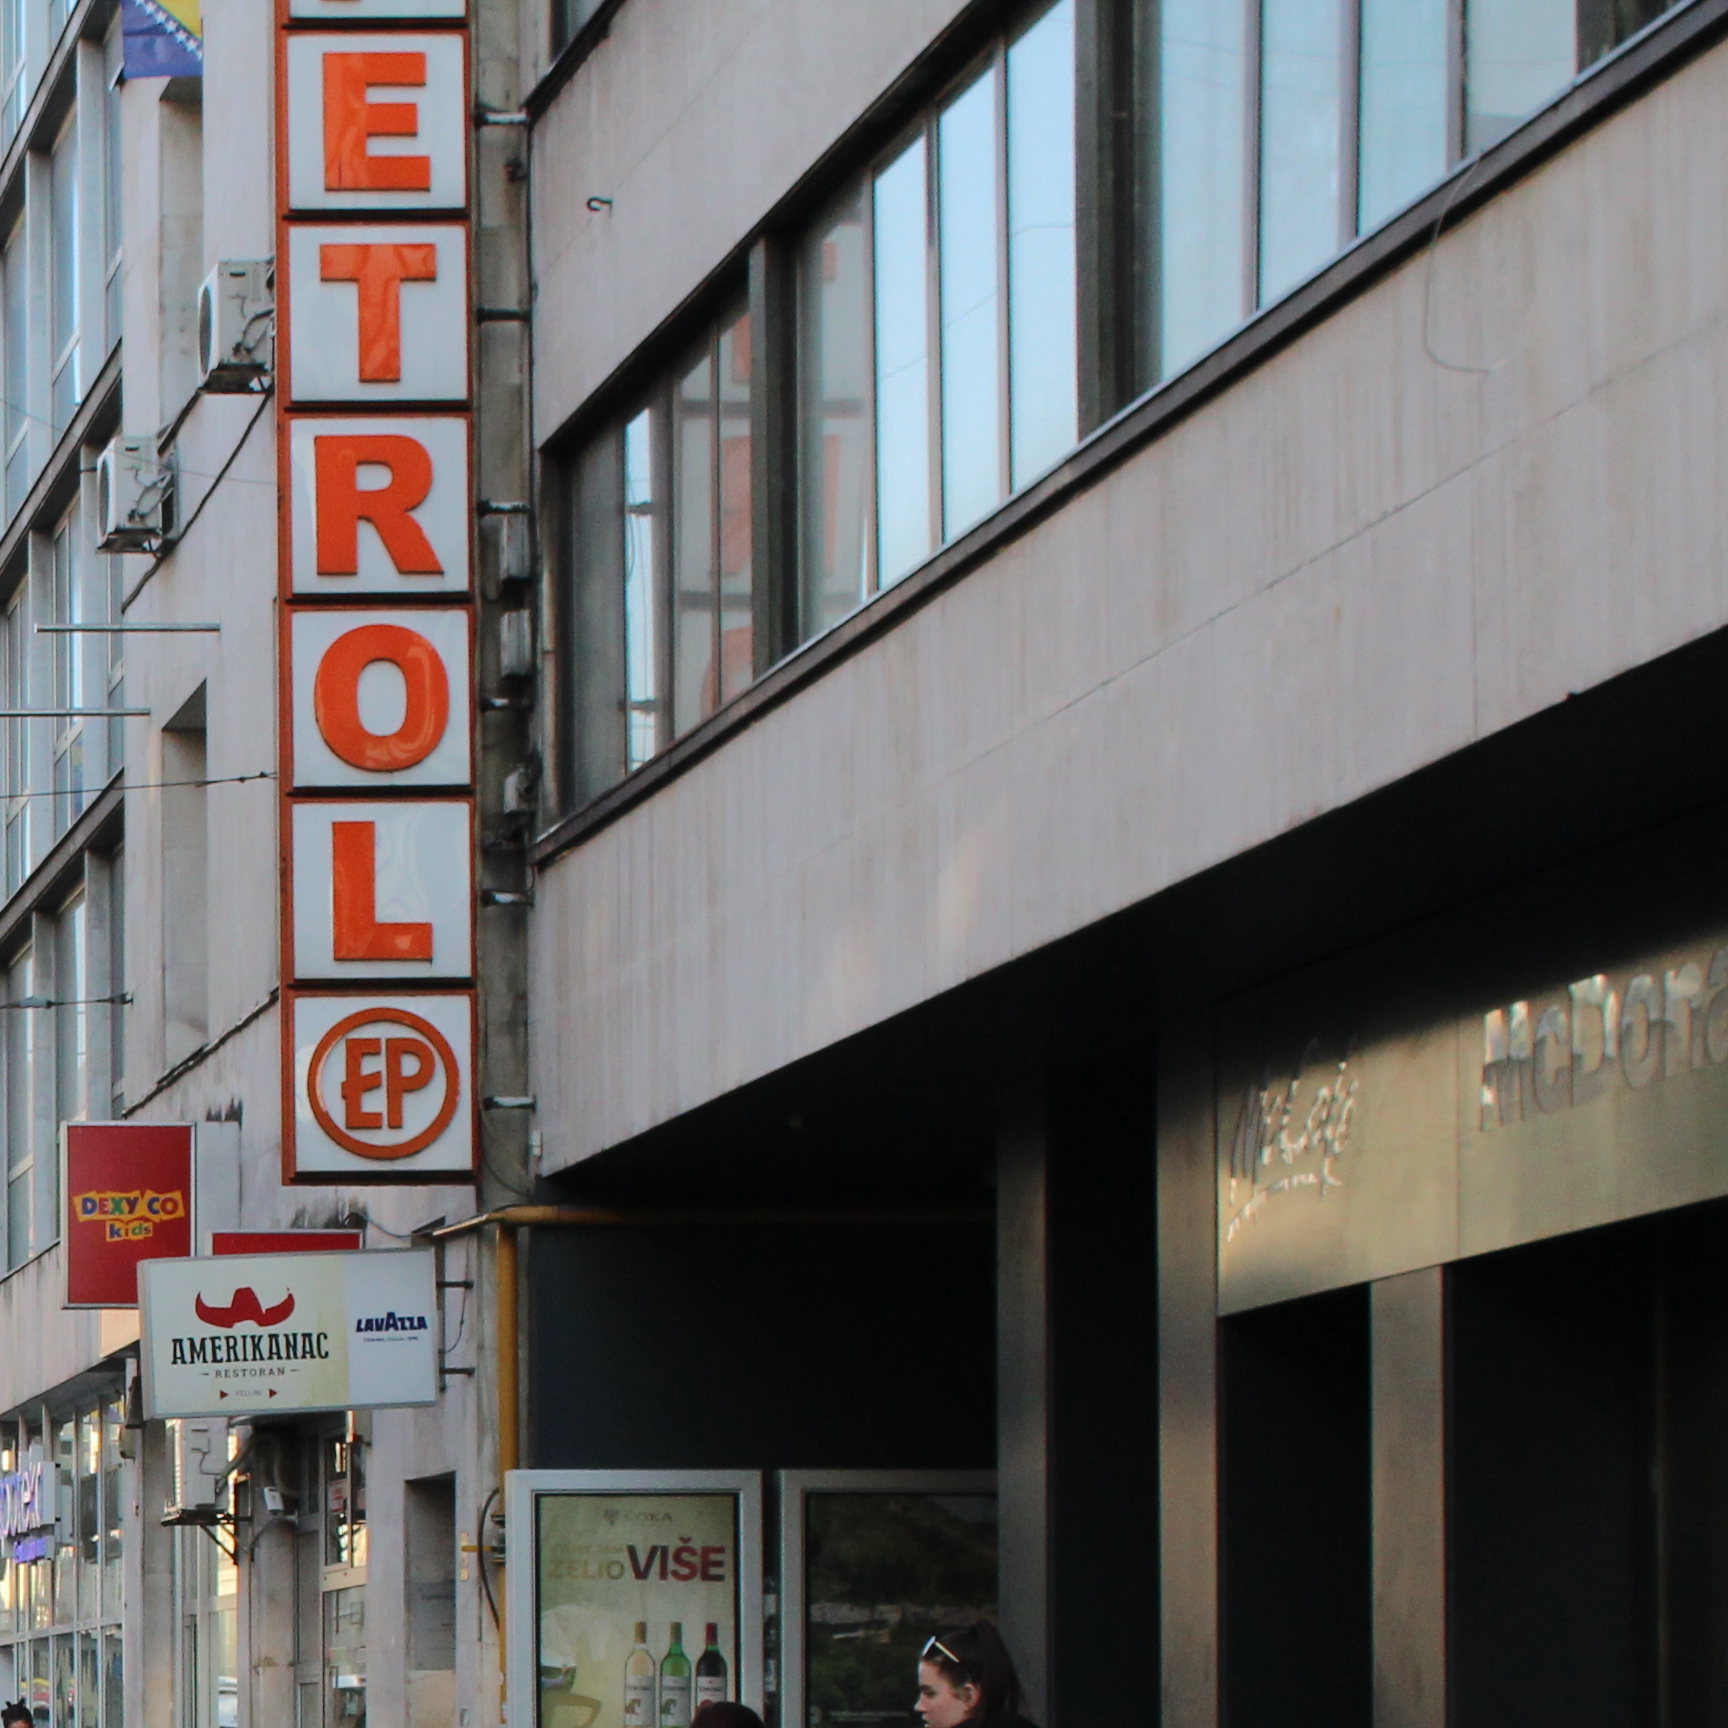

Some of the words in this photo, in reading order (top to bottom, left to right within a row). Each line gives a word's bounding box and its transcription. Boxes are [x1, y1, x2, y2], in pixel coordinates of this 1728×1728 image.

[314, 0, 450, 961] ETROL
[341, 1037, 435, 1130] EP
[81, 1197, 139, 1215] DEXY
[147, 1197, 179, 1215] CO
[109, 1223, 152, 1239] kids
[355, 1312, 428, 1333] LAVAZZA
[171, 1332, 330, 1365] AMERIKANAC
[215, 1367, 286, 1379] RESTORAN
[626, 1536, 726, 1582] VIŠE
